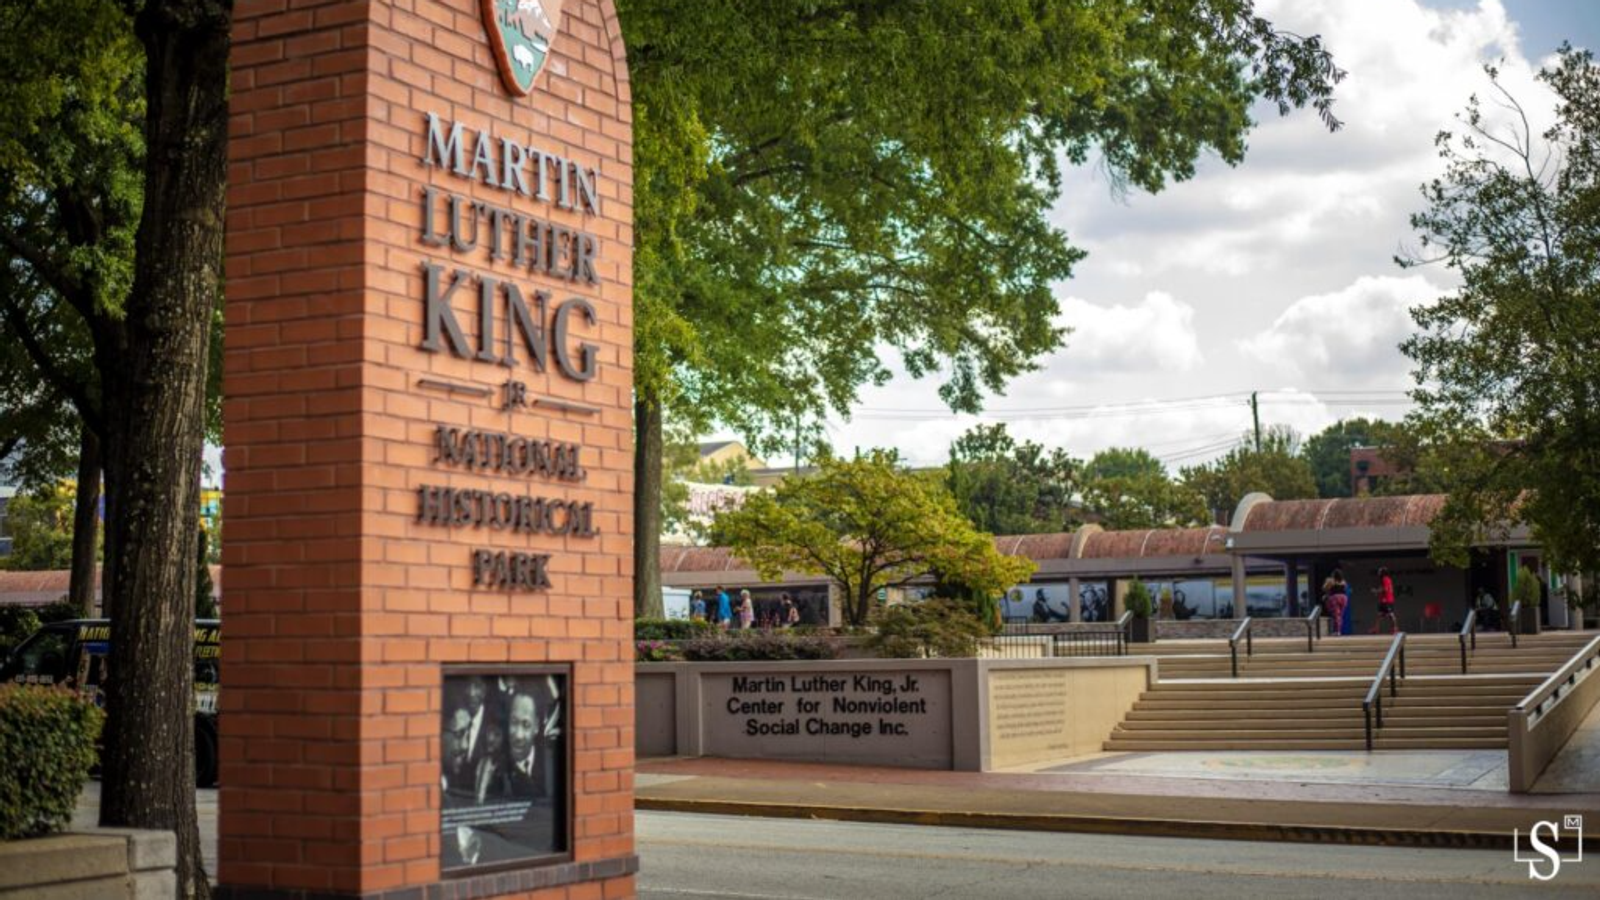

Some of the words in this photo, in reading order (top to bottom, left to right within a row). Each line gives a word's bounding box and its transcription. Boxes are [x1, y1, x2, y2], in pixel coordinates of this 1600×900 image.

[422, 110, 600, 217] MARTIN
[420, 184, 599, 285] LUTHER
[418, 259, 600, 382] KING
[501, 379, 527, 413] JR
[431, 425, 587, 482] NATIONAL
[413, 484, 600, 539] HISTORICAL
[471, 549, 553, 590] PARK
[727, 697, 784, 714] Center
[796, 697, 820, 714] for
[833, 697, 926, 714] Nonviolent
[732, 676, 785, 693] Martin
[791, 675, 847, 692] Luther
[853, 675, 897, 695] King,
[900, 675, 919, 692] Jr.
[746, 718, 799, 736] Social
[805, 718, 872, 738] Change
[879, 718, 909, 736] Inc.
